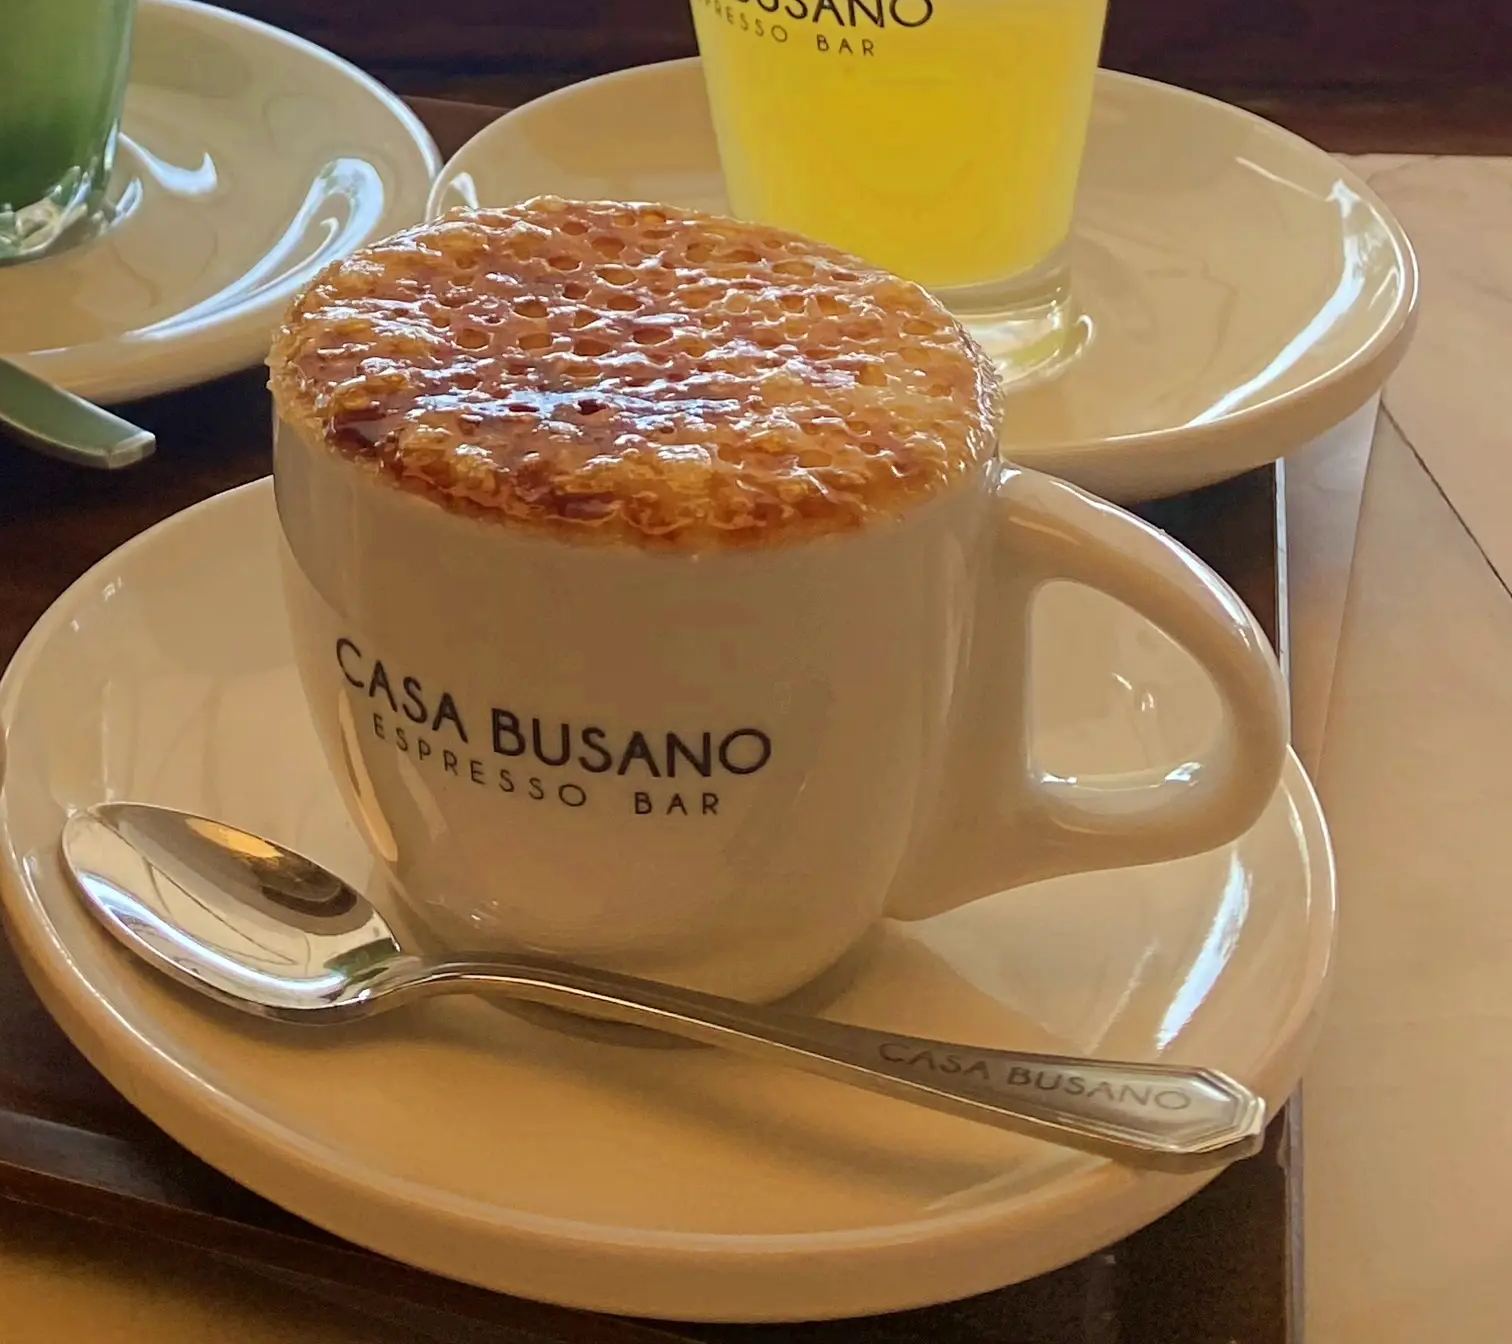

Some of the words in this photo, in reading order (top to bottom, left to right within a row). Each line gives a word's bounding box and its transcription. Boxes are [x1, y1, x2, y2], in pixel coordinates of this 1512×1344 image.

[816, 34, 874, 56] BAR
[335, 637, 469, 744] CASA
[491, 707, 773, 779] BUSANO
[373, 713, 588, 807] ESPRESSO
[634, 791, 720, 815] BAR
[878, 1041, 989, 1080] CASA
[1006, 1065, 1192, 1112] BUSANO
